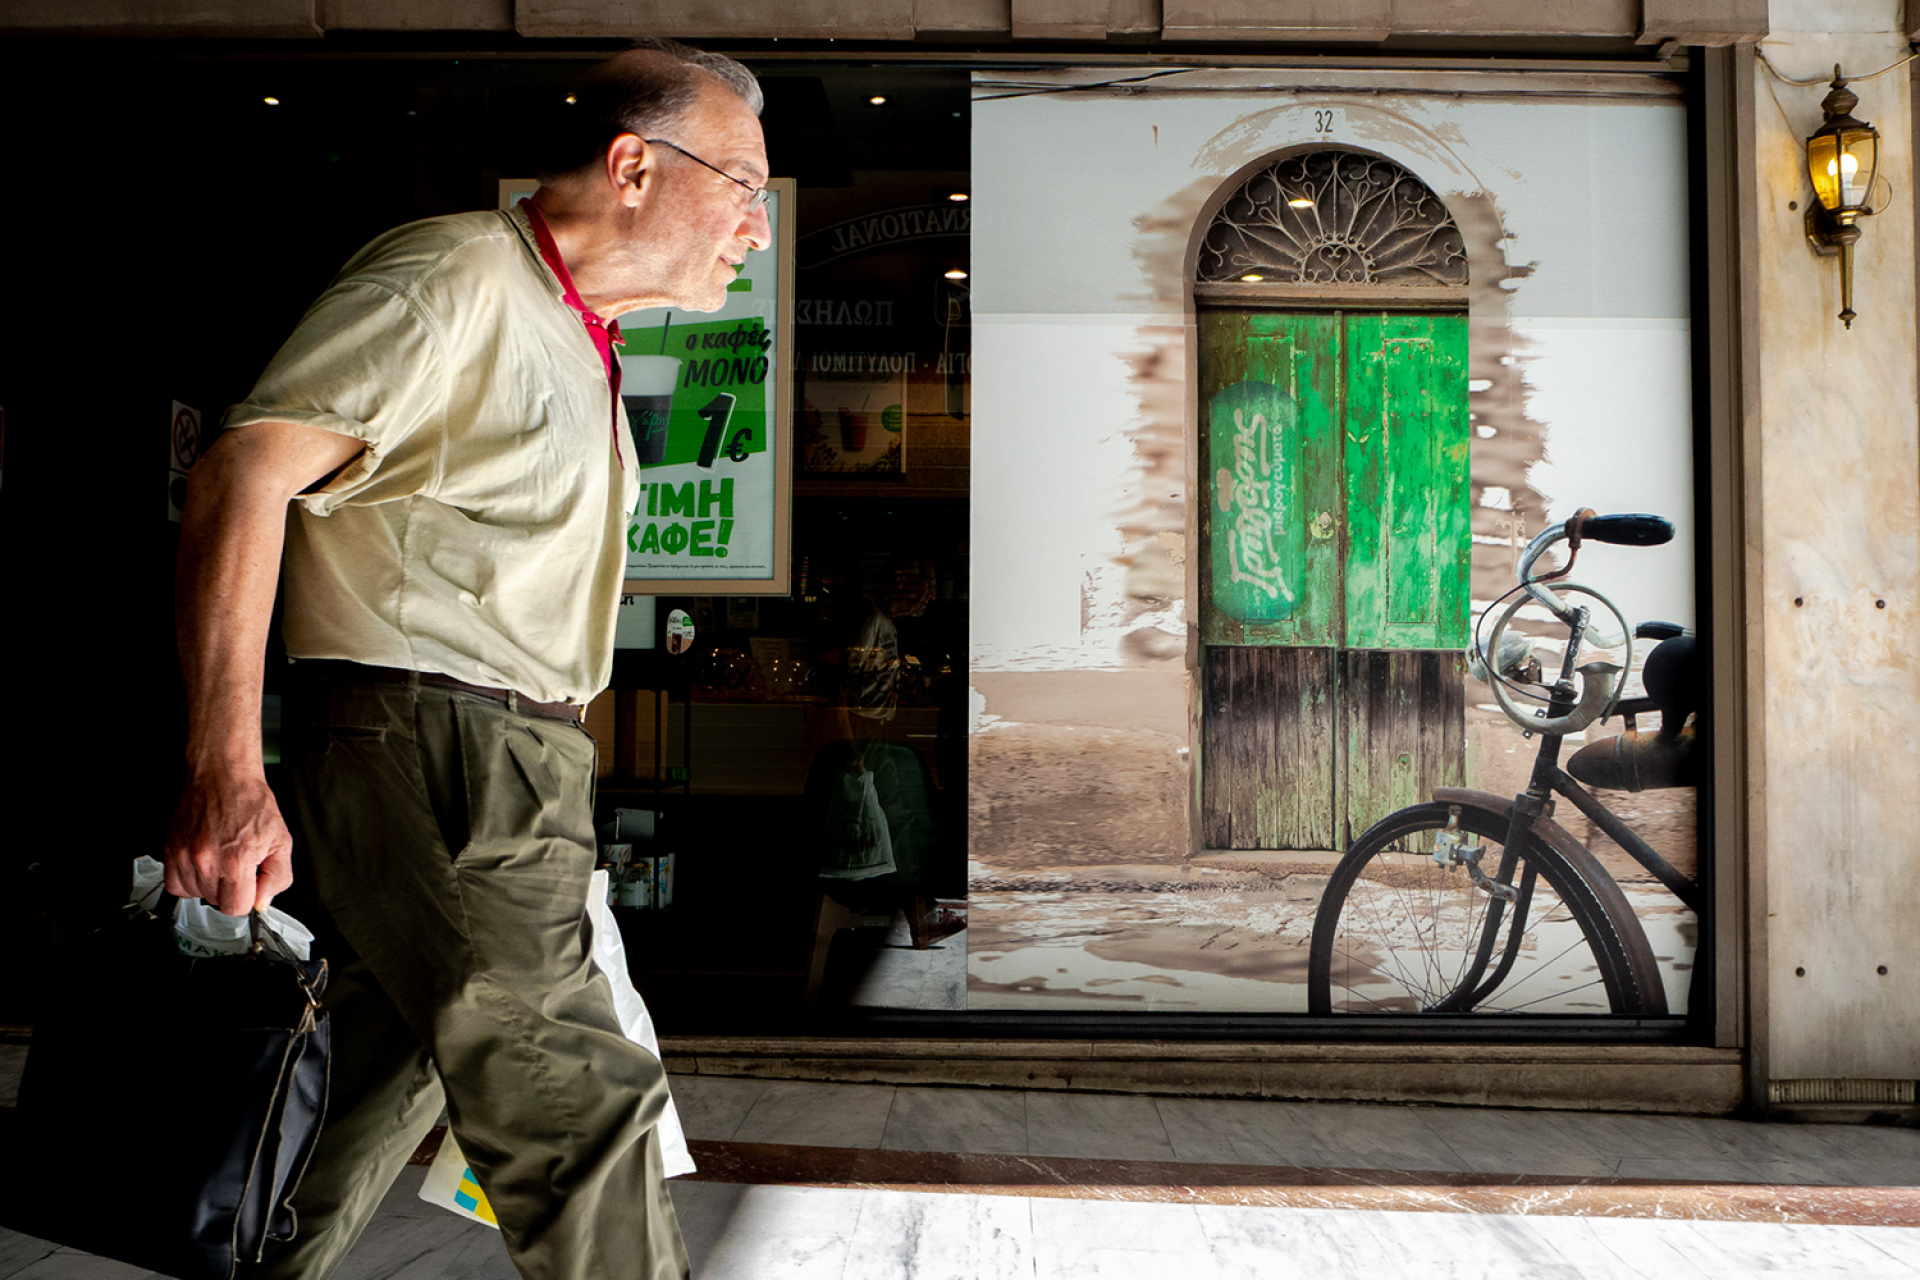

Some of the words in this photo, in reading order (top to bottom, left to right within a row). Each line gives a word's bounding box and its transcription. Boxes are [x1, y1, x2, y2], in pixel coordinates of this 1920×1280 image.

[1314, 109, 1334, 133] 32
[685, 332, 698, 351] ο
[701, 323, 773, 355] καφές
[684, 355, 769, 388] ΜΟΝΟ
[1271, 424, 1287, 536] μικρογεύματα
